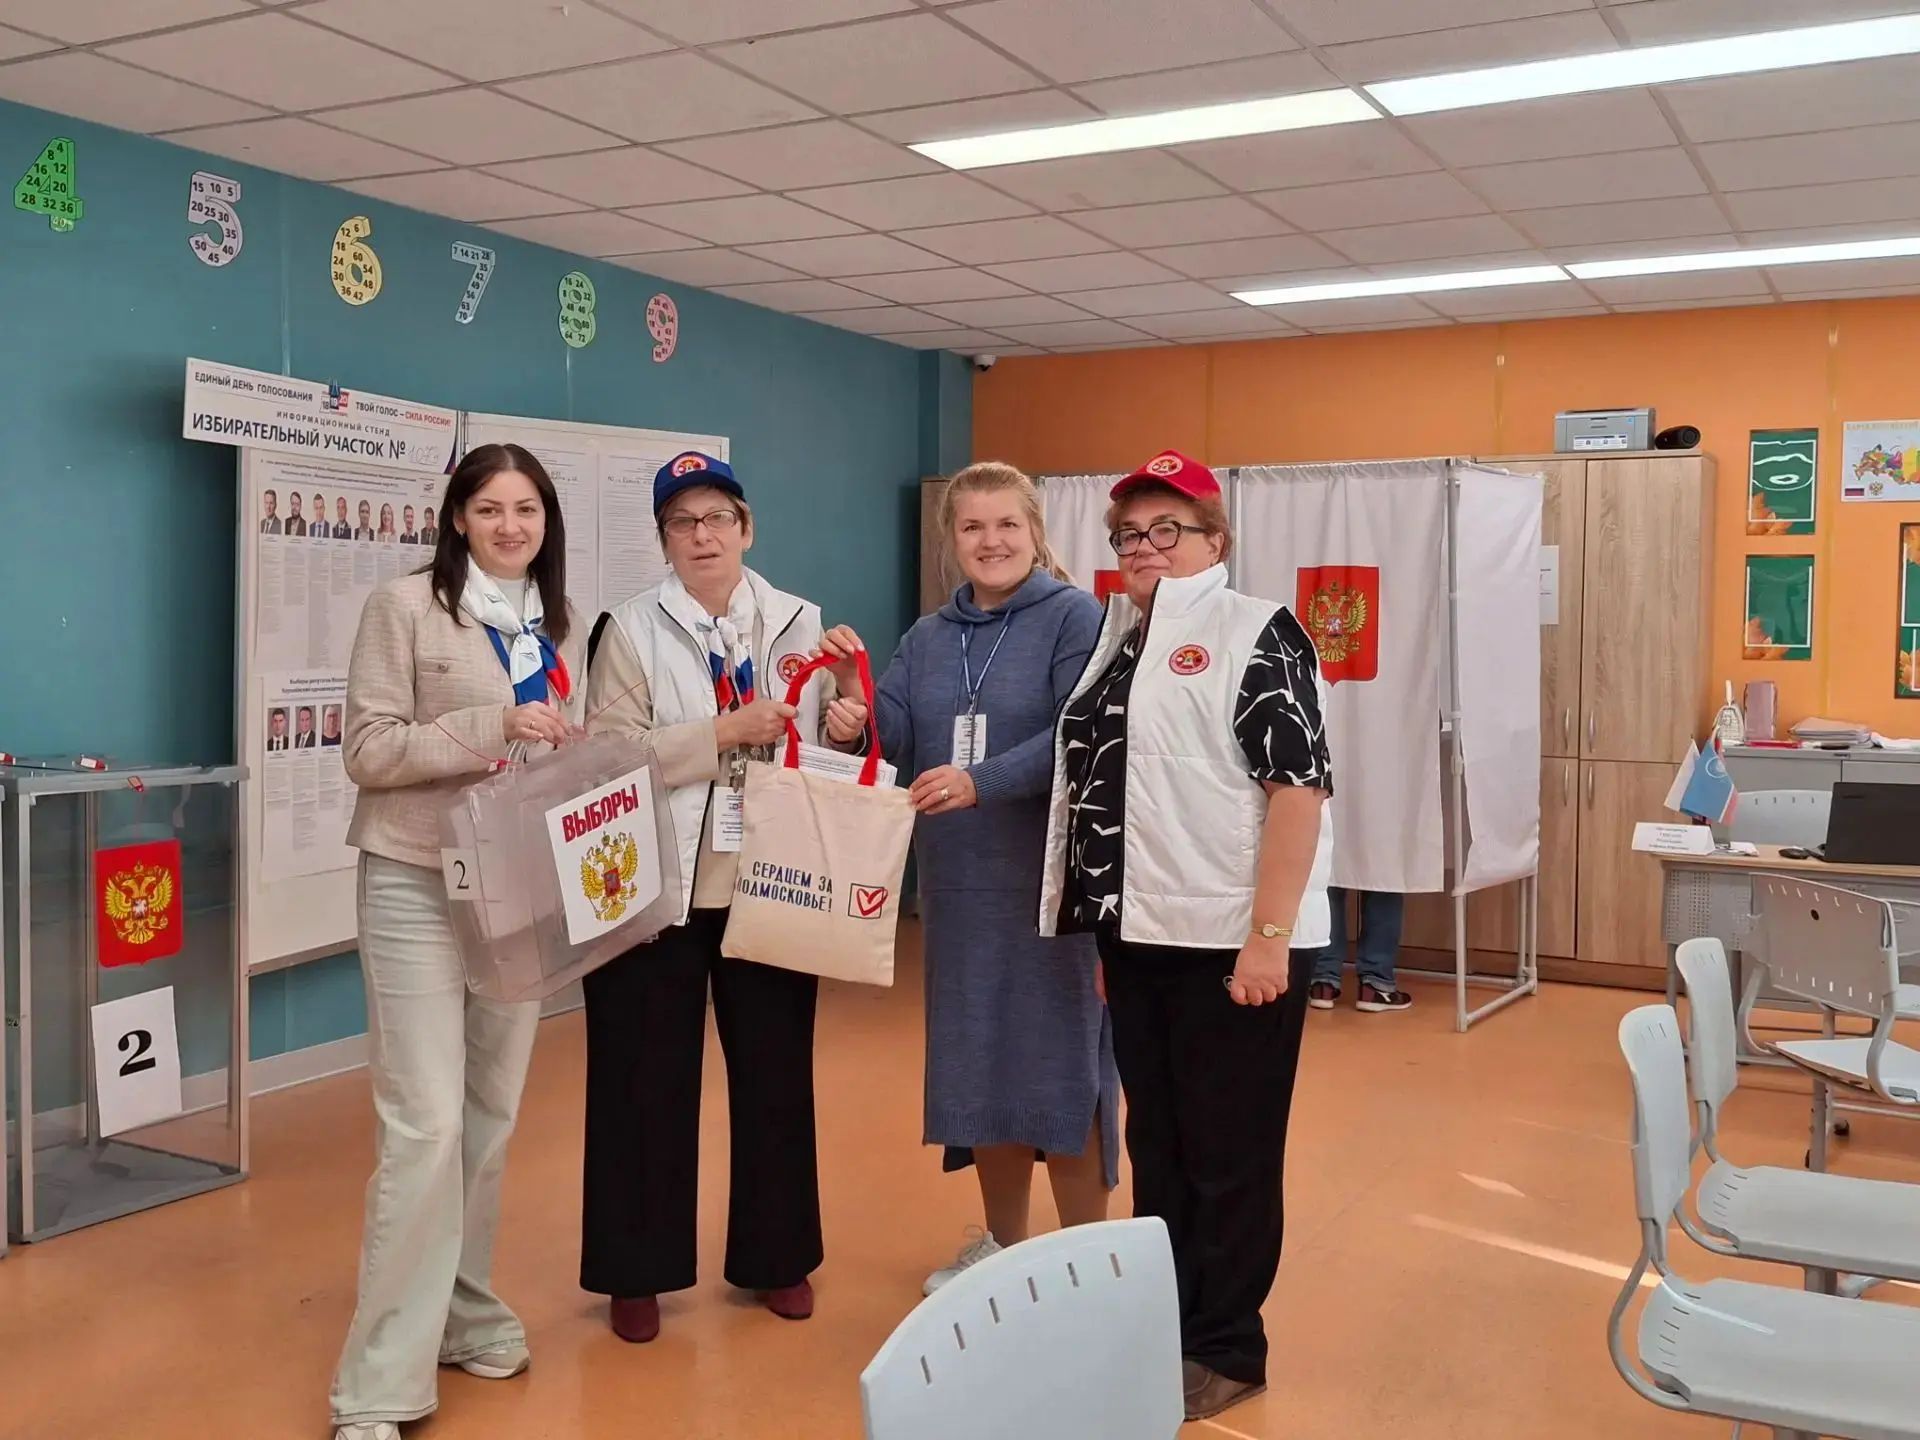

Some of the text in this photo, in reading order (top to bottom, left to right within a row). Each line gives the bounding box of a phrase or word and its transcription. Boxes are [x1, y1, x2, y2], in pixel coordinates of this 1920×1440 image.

[57, 143, 64, 152] 4
[48, 150, 54, 160] 8
[34, 162, 66, 175] 16 12
[14, 137, 83, 233] 4
[26, 175, 66, 193] 24 20
[193, 182, 233, 196] 15 10 5
[21, 193, 73, 213] 28 32 36
[191, 201, 229, 222] 20 25 30
[188, 170, 243, 267] 5
[225, 228, 236, 239] 35
[341, 224, 359, 237] 12 6
[195, 240, 206, 251] 50
[223, 245, 233, 255] 40
[336, 241, 345, 251] 18
[208, 252, 219, 263] 45
[353, 252, 363, 262] 60
[461, 248, 469, 257] 14
[471, 251, 479, 260] 21
[331, 216, 382, 306] 6
[333, 256, 344, 265] 24
[363, 265, 373, 274] 54
[480, 263, 488, 272] 35
[333, 271, 344, 281] 30
[476, 273, 483, 281] 42
[364, 280, 373, 289] 48
[452, 241, 495, 324] 7
[471, 281, 480, 289] 49
[576, 280, 584, 288] 24
[341, 286, 351, 296] 36
[353, 291, 363, 300] 42
[467, 290, 475, 299] 56
[461, 302, 470, 310] 63
[558, 271, 596, 348] 8
[459, 311, 467, 320] 70
[647, 293, 678, 362] 9
[195, 372, 313, 402] ЕДИНЫЙ ДЕНЬ ГОЛОСОВАНИЯ
[356, 402, 375, 411] ТВОЙ
[376, 406, 398, 417] ГОЛОС
[405, 411, 423, 421] СИЛА
[277, 411, 390, 437] ИНФОРМАЦИОННЫЙ СТЕНД
[193, 413, 405, 460] ИЗБИРАТЕЛЬНЫЙ УЧАСТОК №
[562, 783, 639, 844] ВЫБОРЫ
[453, 860, 469, 889] 2
[752, 861, 832, 894] СЕРДЦЕМ ЗА
[118, 1029, 156, 1077] 2
